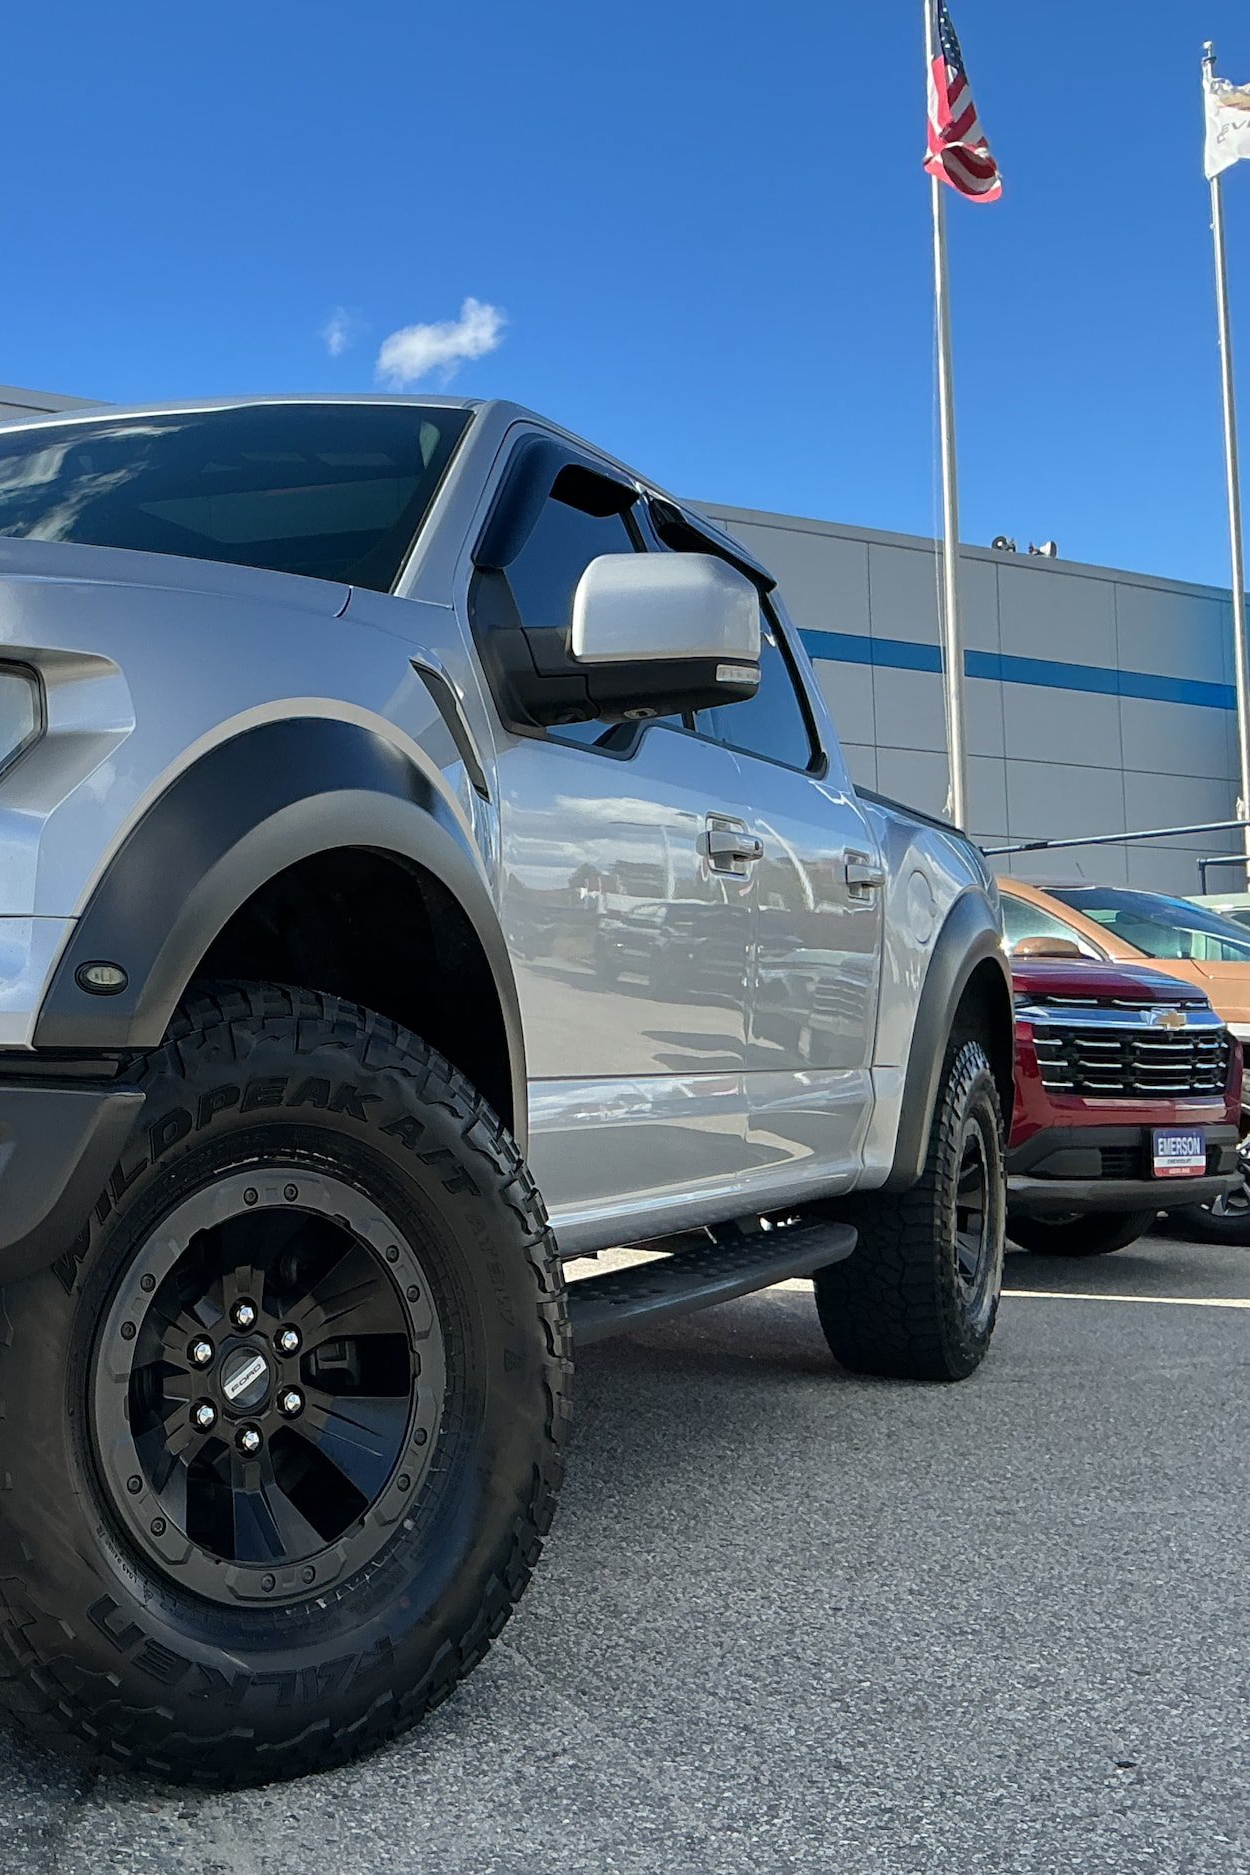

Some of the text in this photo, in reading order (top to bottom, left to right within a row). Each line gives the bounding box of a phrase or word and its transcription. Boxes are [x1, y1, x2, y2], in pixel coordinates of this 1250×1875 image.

[1158, 1137, 1200, 1155] EMERSON
[52, 1075, 481, 1297] WILDPEAK A/T
[230, 1363, 262, 1393] FORD
